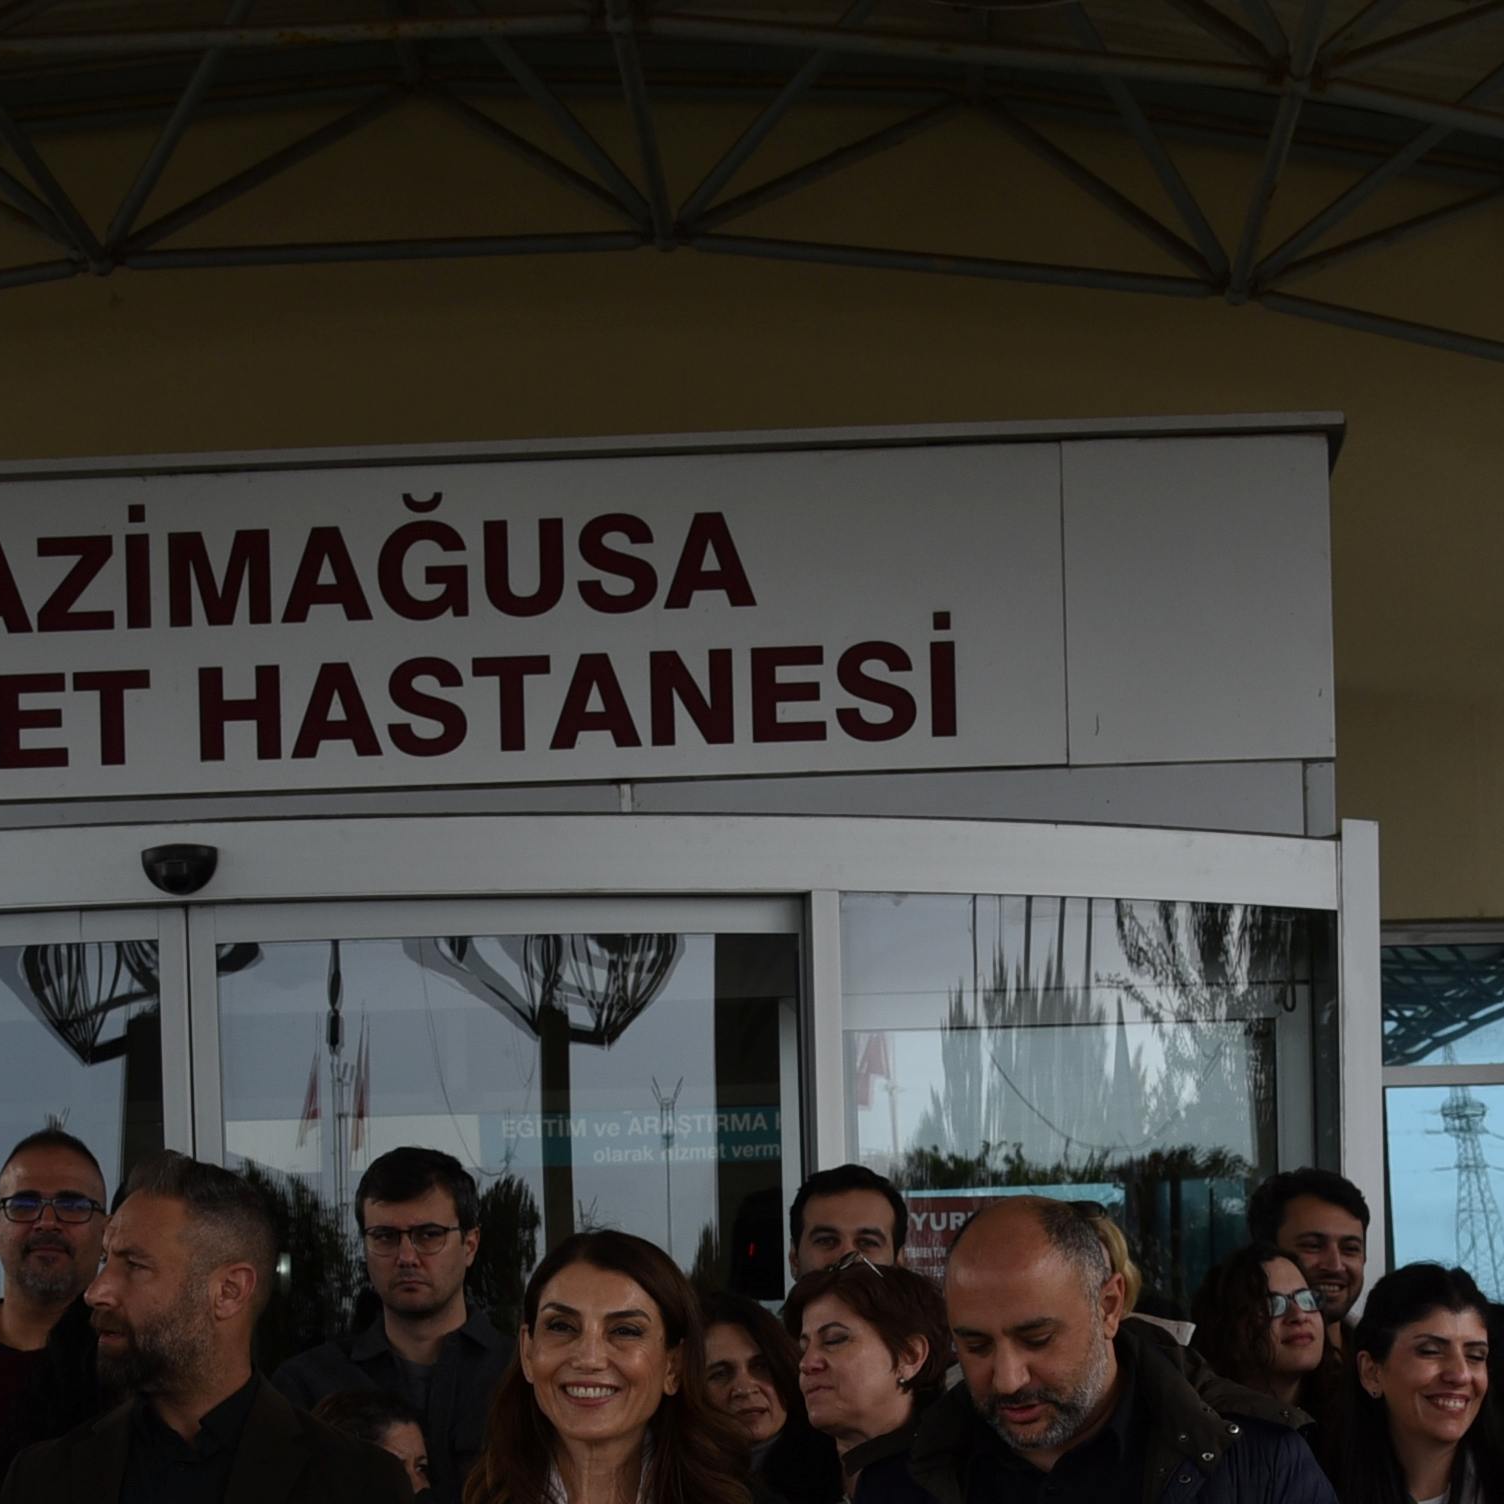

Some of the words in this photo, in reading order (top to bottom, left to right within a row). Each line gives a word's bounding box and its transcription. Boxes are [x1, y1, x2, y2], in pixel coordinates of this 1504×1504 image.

[198, 611, 958, 762] HASTANESİ
[502, 1114, 587, 1138] EĞİTİM
[594, 1122, 620, 1137] ve
[627, 1112, 769, 1140] ARAŞTIRMA
[593, 1146, 654, 1163] olarak
[909, 1211, 973, 1232] YUR
